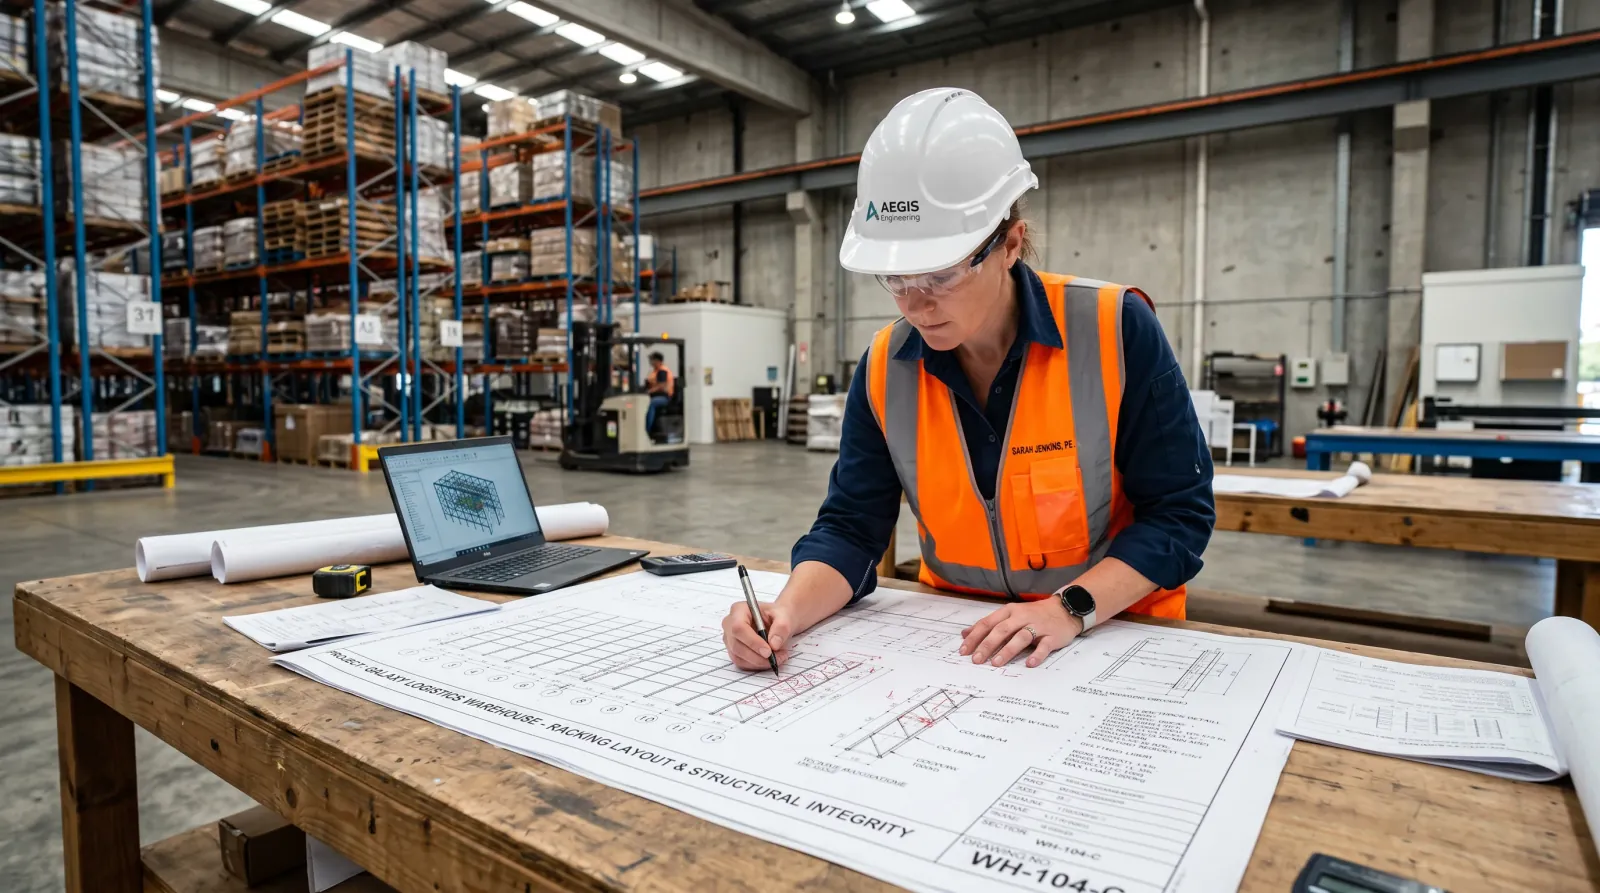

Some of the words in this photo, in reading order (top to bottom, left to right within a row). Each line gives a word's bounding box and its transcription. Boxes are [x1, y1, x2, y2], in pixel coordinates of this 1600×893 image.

[881, 201, 919, 213] AEGIS
[881, 215, 920, 223] Engineering
[1012, 446, 1033, 455] SARAH
[1035, 442, 1063, 453] JENKINS,
[959, 729, 995, 741] COLUMN
[329, 650, 368, 669] PROJECT:
[365, 666, 411, 683] GALAXY
[404, 680, 465, 701] LOGISTICS
[463, 698, 543, 726] WAREHOUSE
[546, 723, 612, 746] RACKING
[610, 742, 676, 767] LAYOUT
[673, 763, 688, 772] &
[688, 767, 801, 807] STRUCTURAL
[806, 801, 915, 838] INTEGRITY
[936, 745, 974, 758] COLUMN
[1085, 767, 1111, 776] LOAD
[981, 819, 1028, 836] SECTION
[961, 838, 1026, 860] DRAWING
[1035, 838, 1102, 862] WH-104-C
